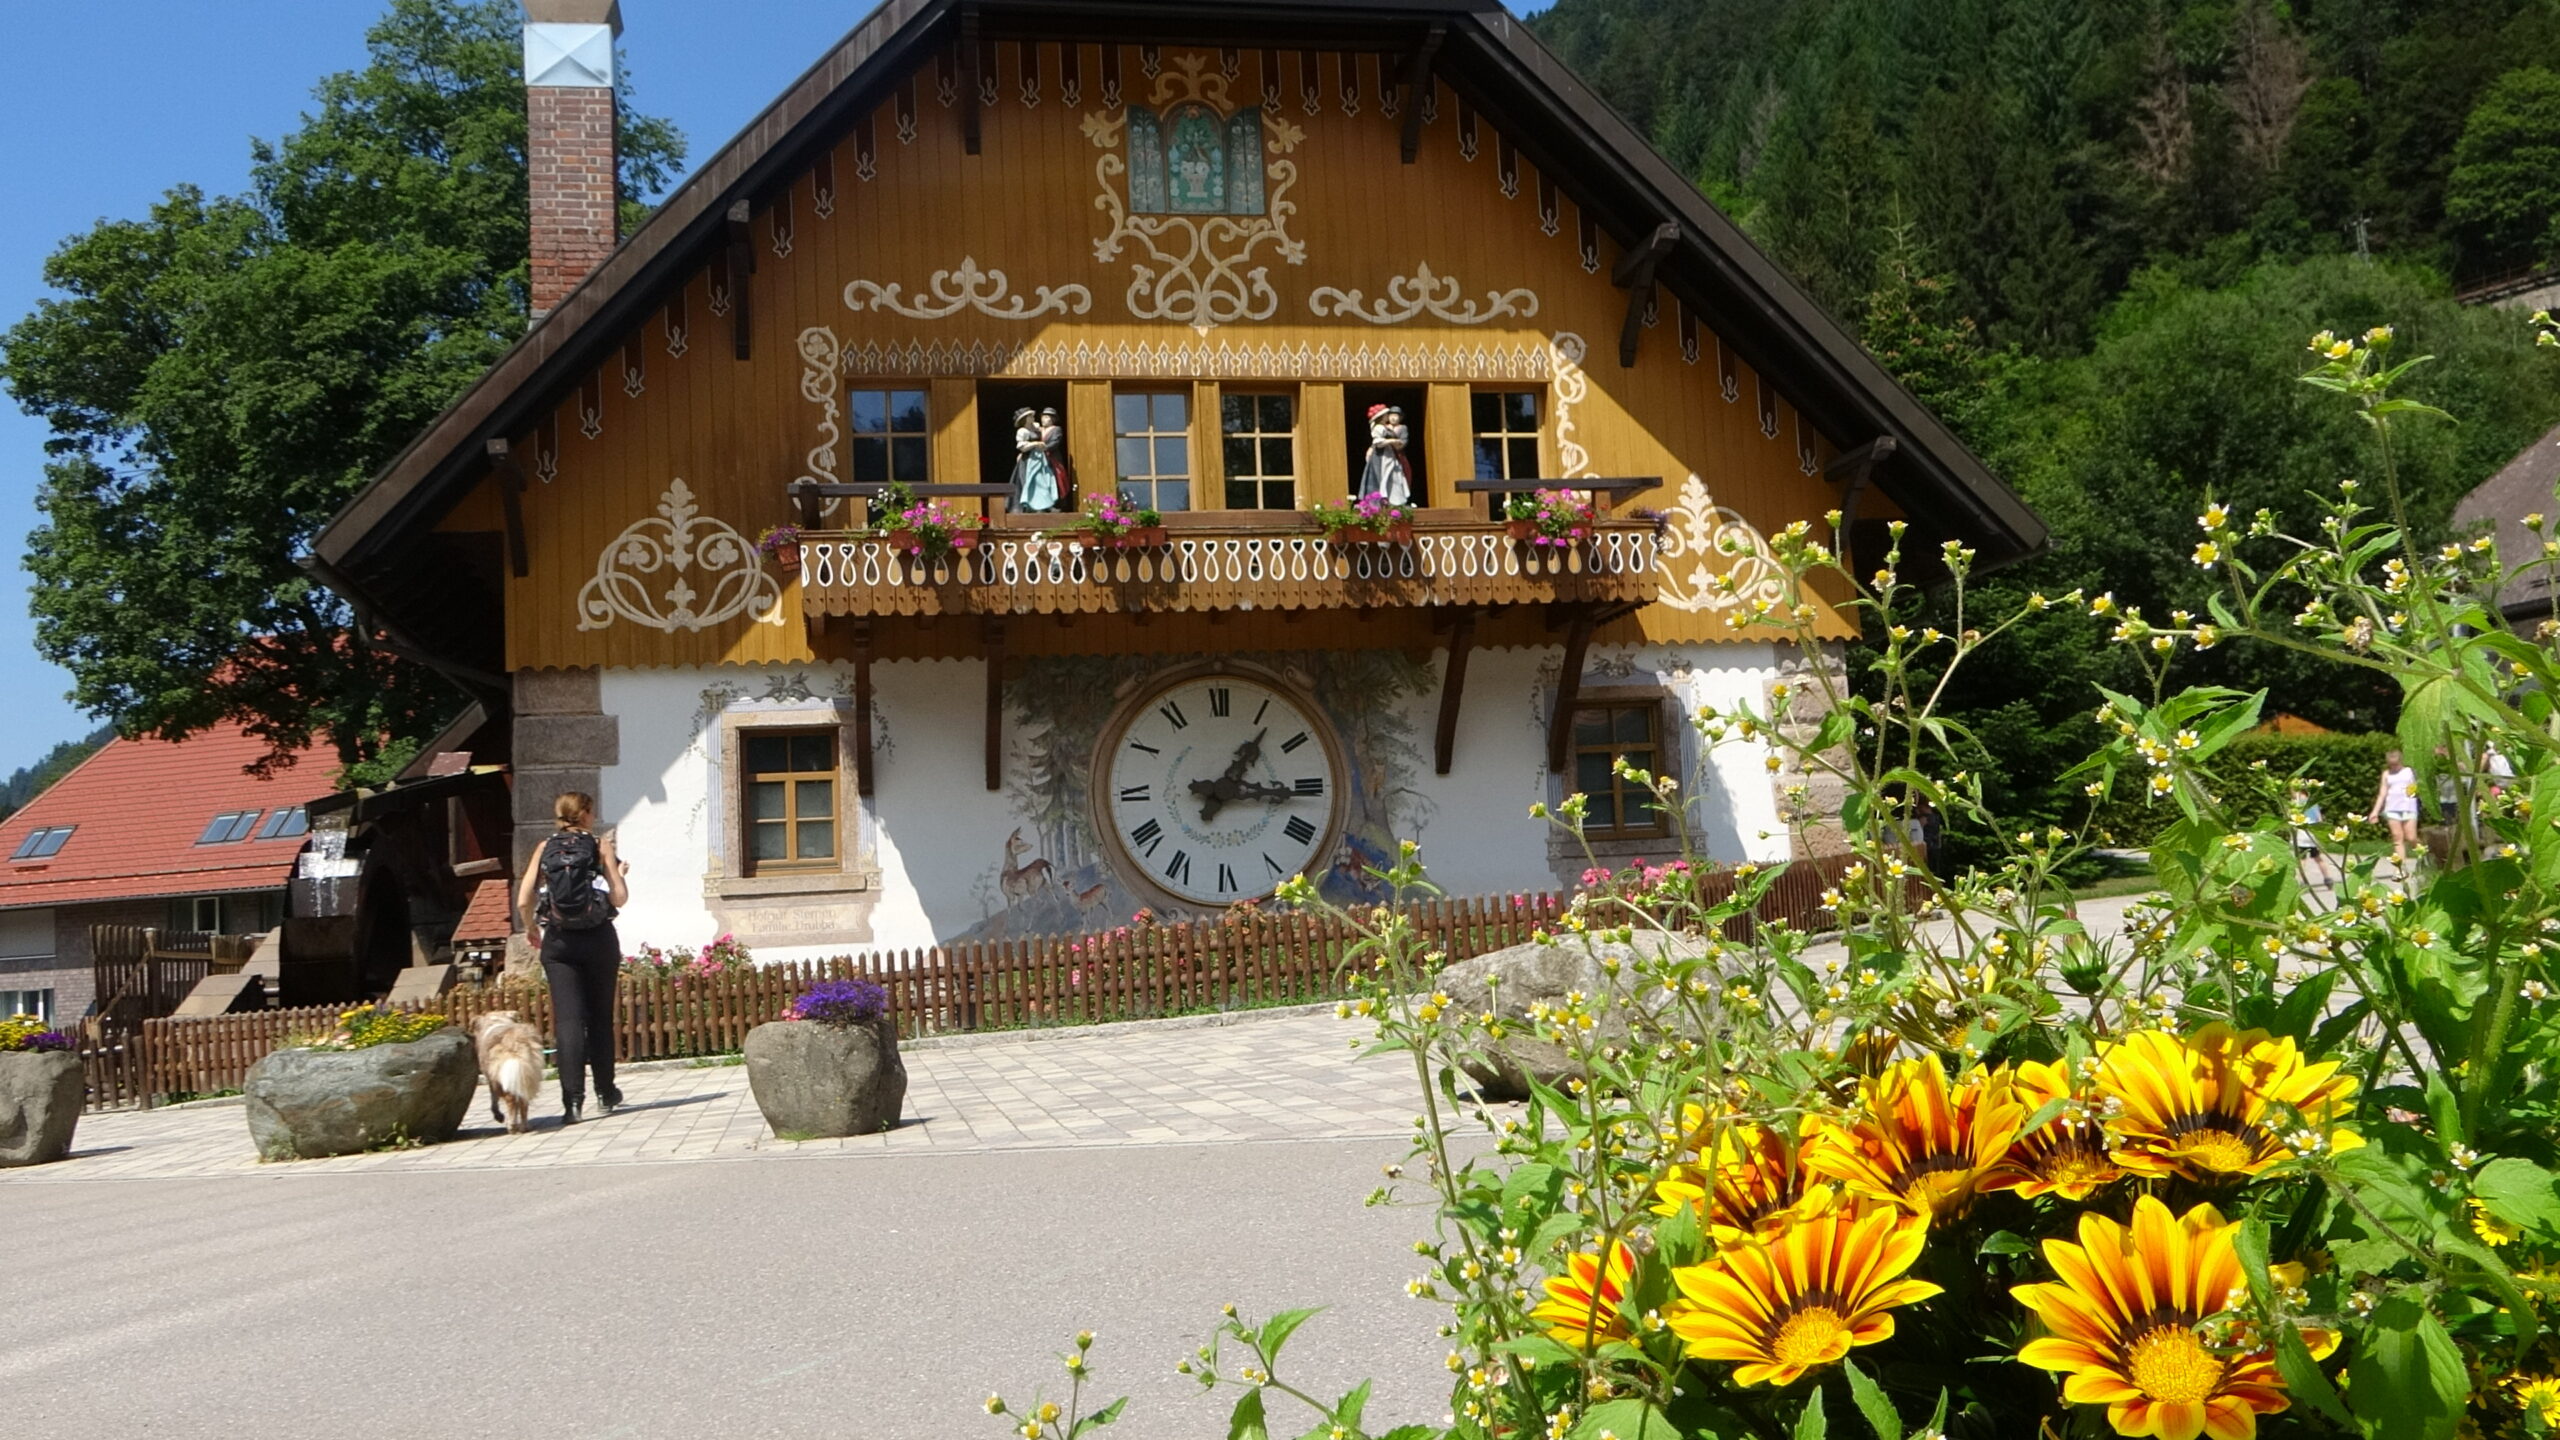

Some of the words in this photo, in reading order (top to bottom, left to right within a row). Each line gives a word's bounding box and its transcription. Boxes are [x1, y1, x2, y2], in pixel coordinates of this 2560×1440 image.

[1207, 688, 1230, 717] XII
[1252, 699, 1270, 725] I
[1159, 700, 1189, 734] XI
[1129, 737, 1160, 759] X
[1280, 731, 1309, 754] II
[1120, 784, 1150, 802] IX
[1294, 778, 1323, 793] III
[1283, 815, 1317, 846] IIII
[1165, 849, 1191, 886] VII
